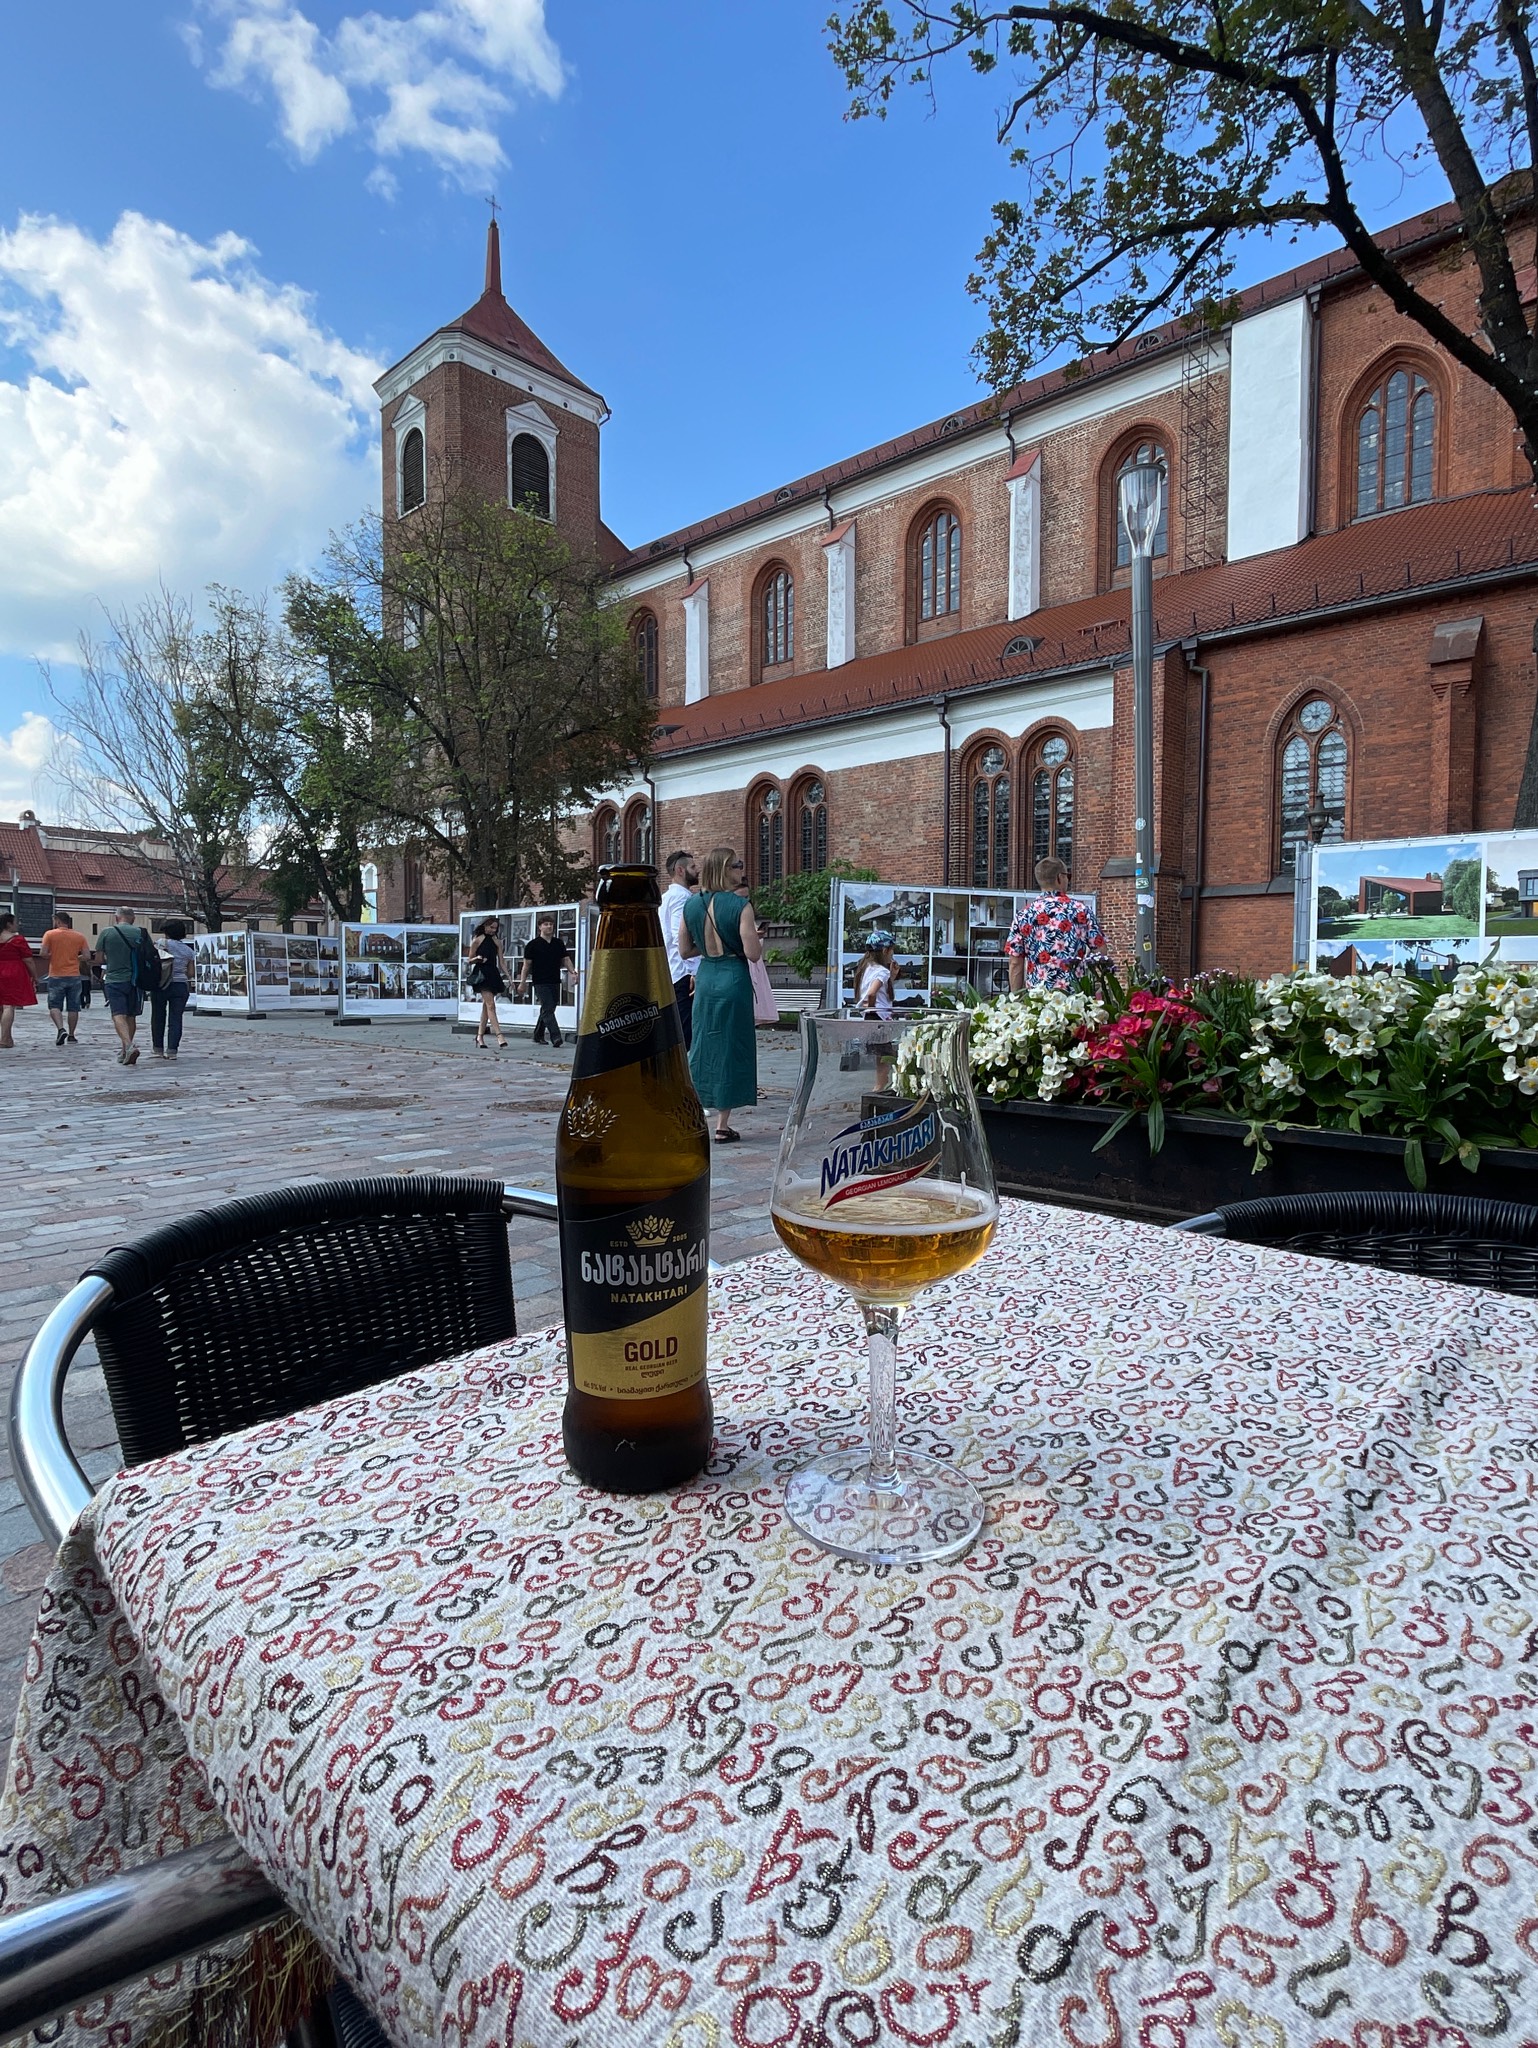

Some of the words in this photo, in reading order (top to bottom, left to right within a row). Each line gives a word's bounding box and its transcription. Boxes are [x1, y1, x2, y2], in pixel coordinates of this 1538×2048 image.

[820, 1112, 935, 1199] NATAKHTARI
[845, 1183, 876, 1196] GEORGIAN
[877, 1173, 908, 1187] LEMONADE
[581, 1238, 706, 1287] ნატახტარი
[610, 1284, 688, 1304] NATAKHTARI
[624, 1336, 678, 1363] GOLD
